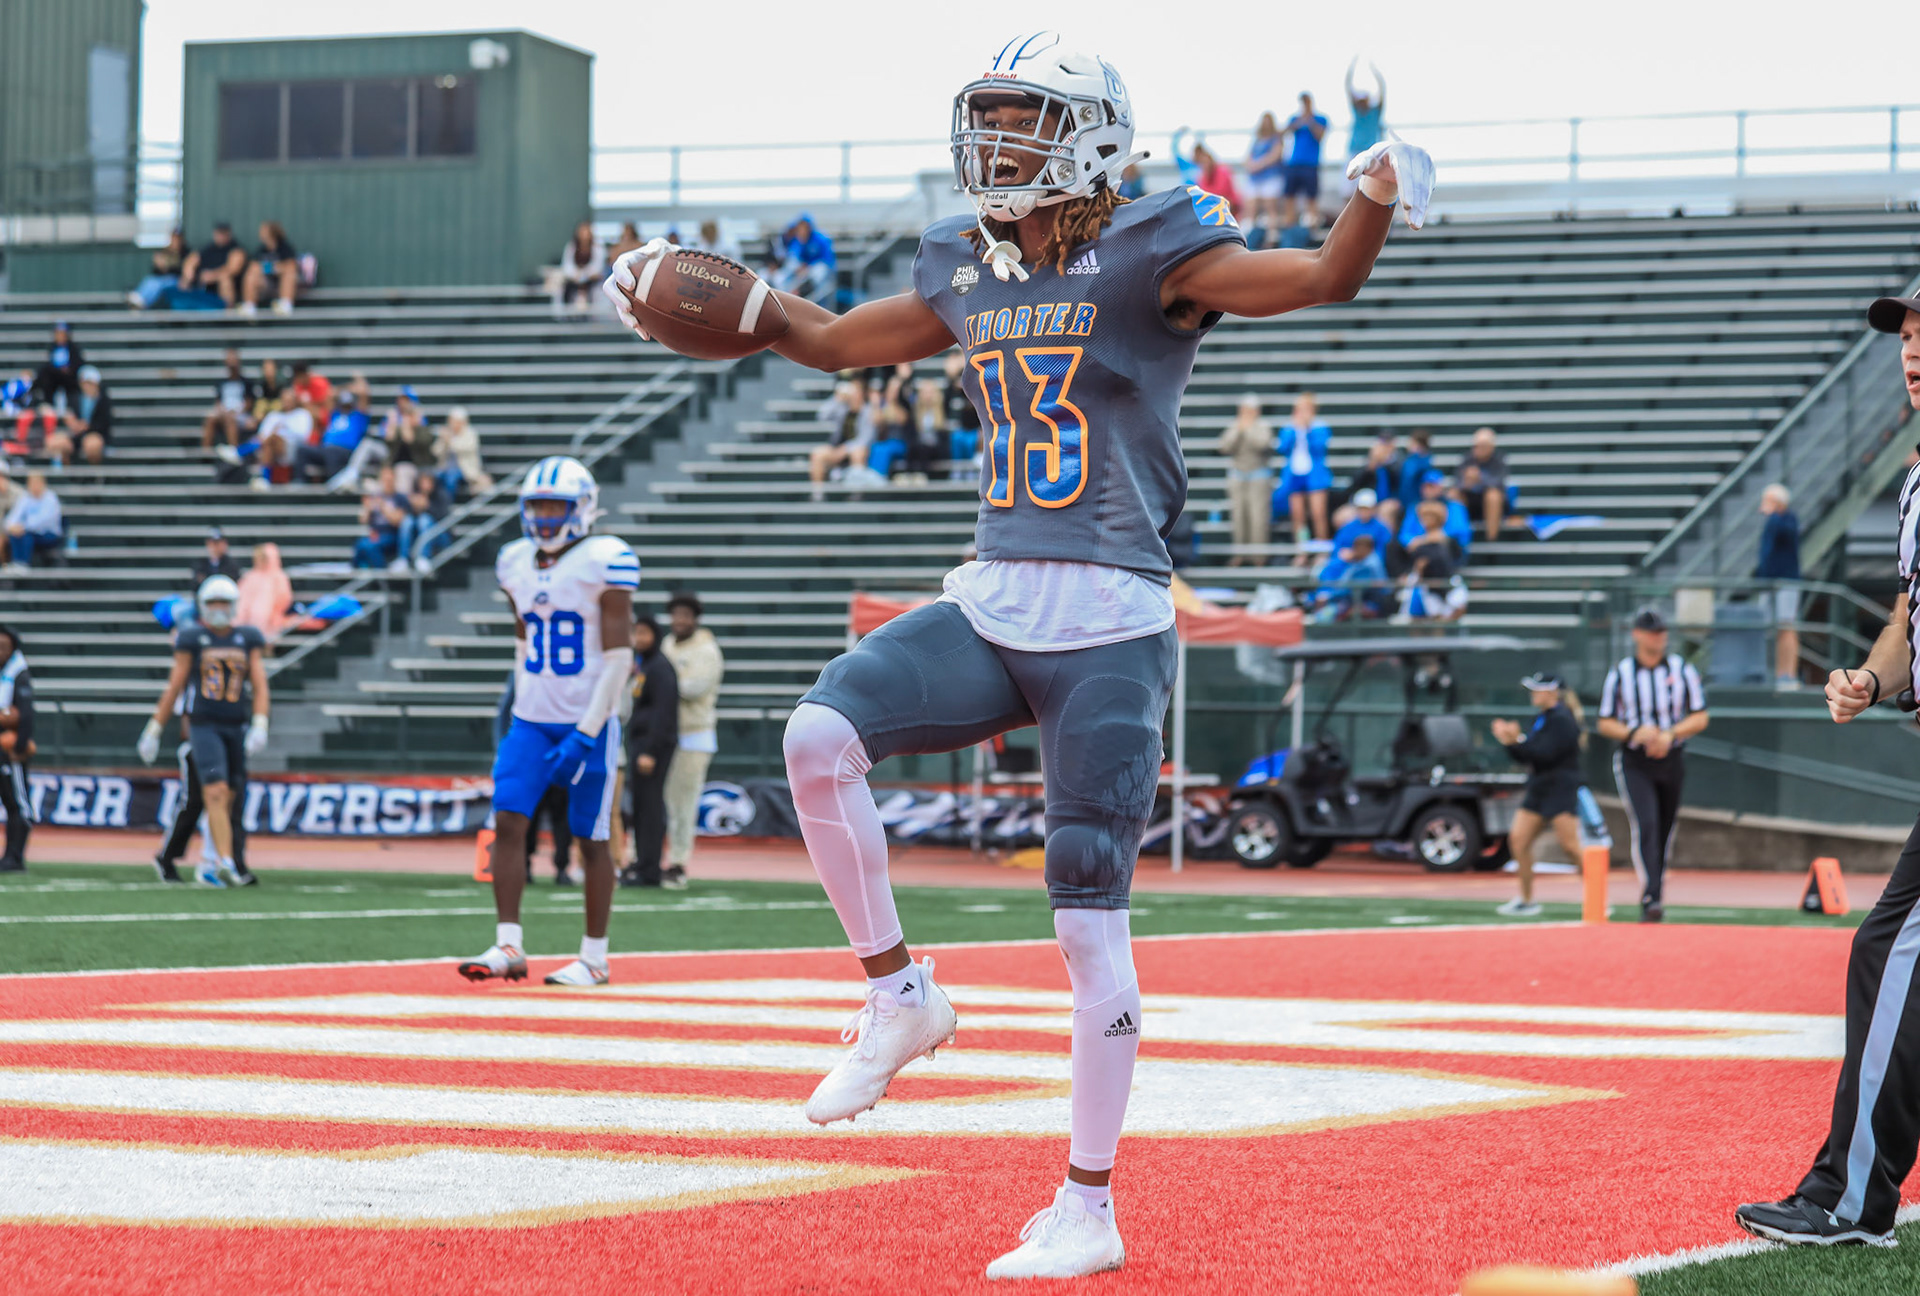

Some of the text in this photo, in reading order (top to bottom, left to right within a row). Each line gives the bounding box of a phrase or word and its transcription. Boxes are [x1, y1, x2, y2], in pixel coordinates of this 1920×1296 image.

[675, 261, 731, 289] Wilson
[956, 265, 976, 275] PHIL
[1066, 264, 1101, 275] adidas
[951, 271, 980, 284] JONES
[679, 301, 703, 314] NCAA
[970, 346, 1089, 509] 13
[523, 610, 585, 676] 38
[0, 774, 133, 827] TER
[1104, 1026, 1138, 1037] adidas
